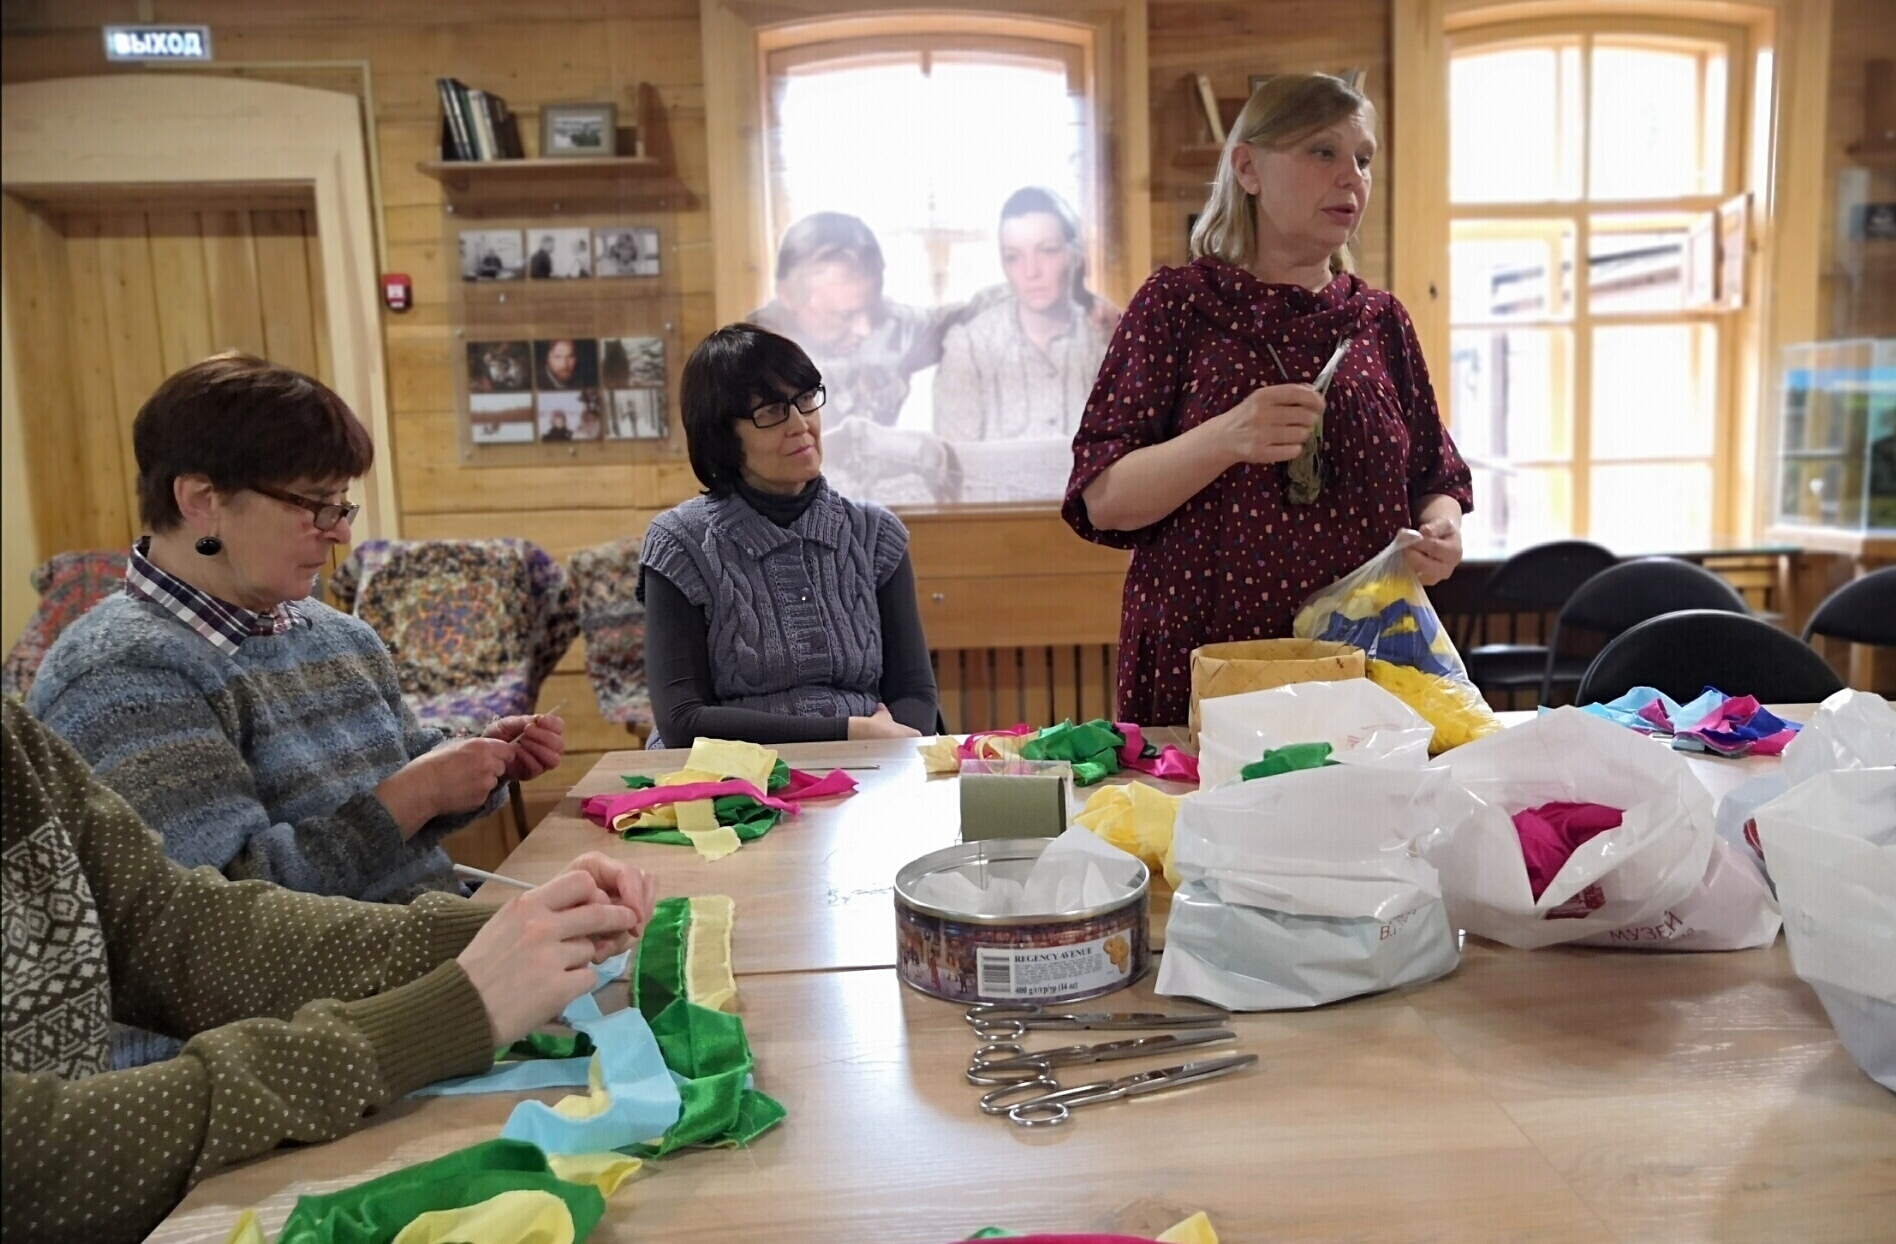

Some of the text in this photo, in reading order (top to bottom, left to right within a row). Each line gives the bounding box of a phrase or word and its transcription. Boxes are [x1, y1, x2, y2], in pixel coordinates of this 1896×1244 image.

[113, 32, 202, 55] ВЫХОД
[1609, 910, 1684, 942] МУЗЕЙ
[1015, 947, 1092, 962] REGENCY AVENUE
